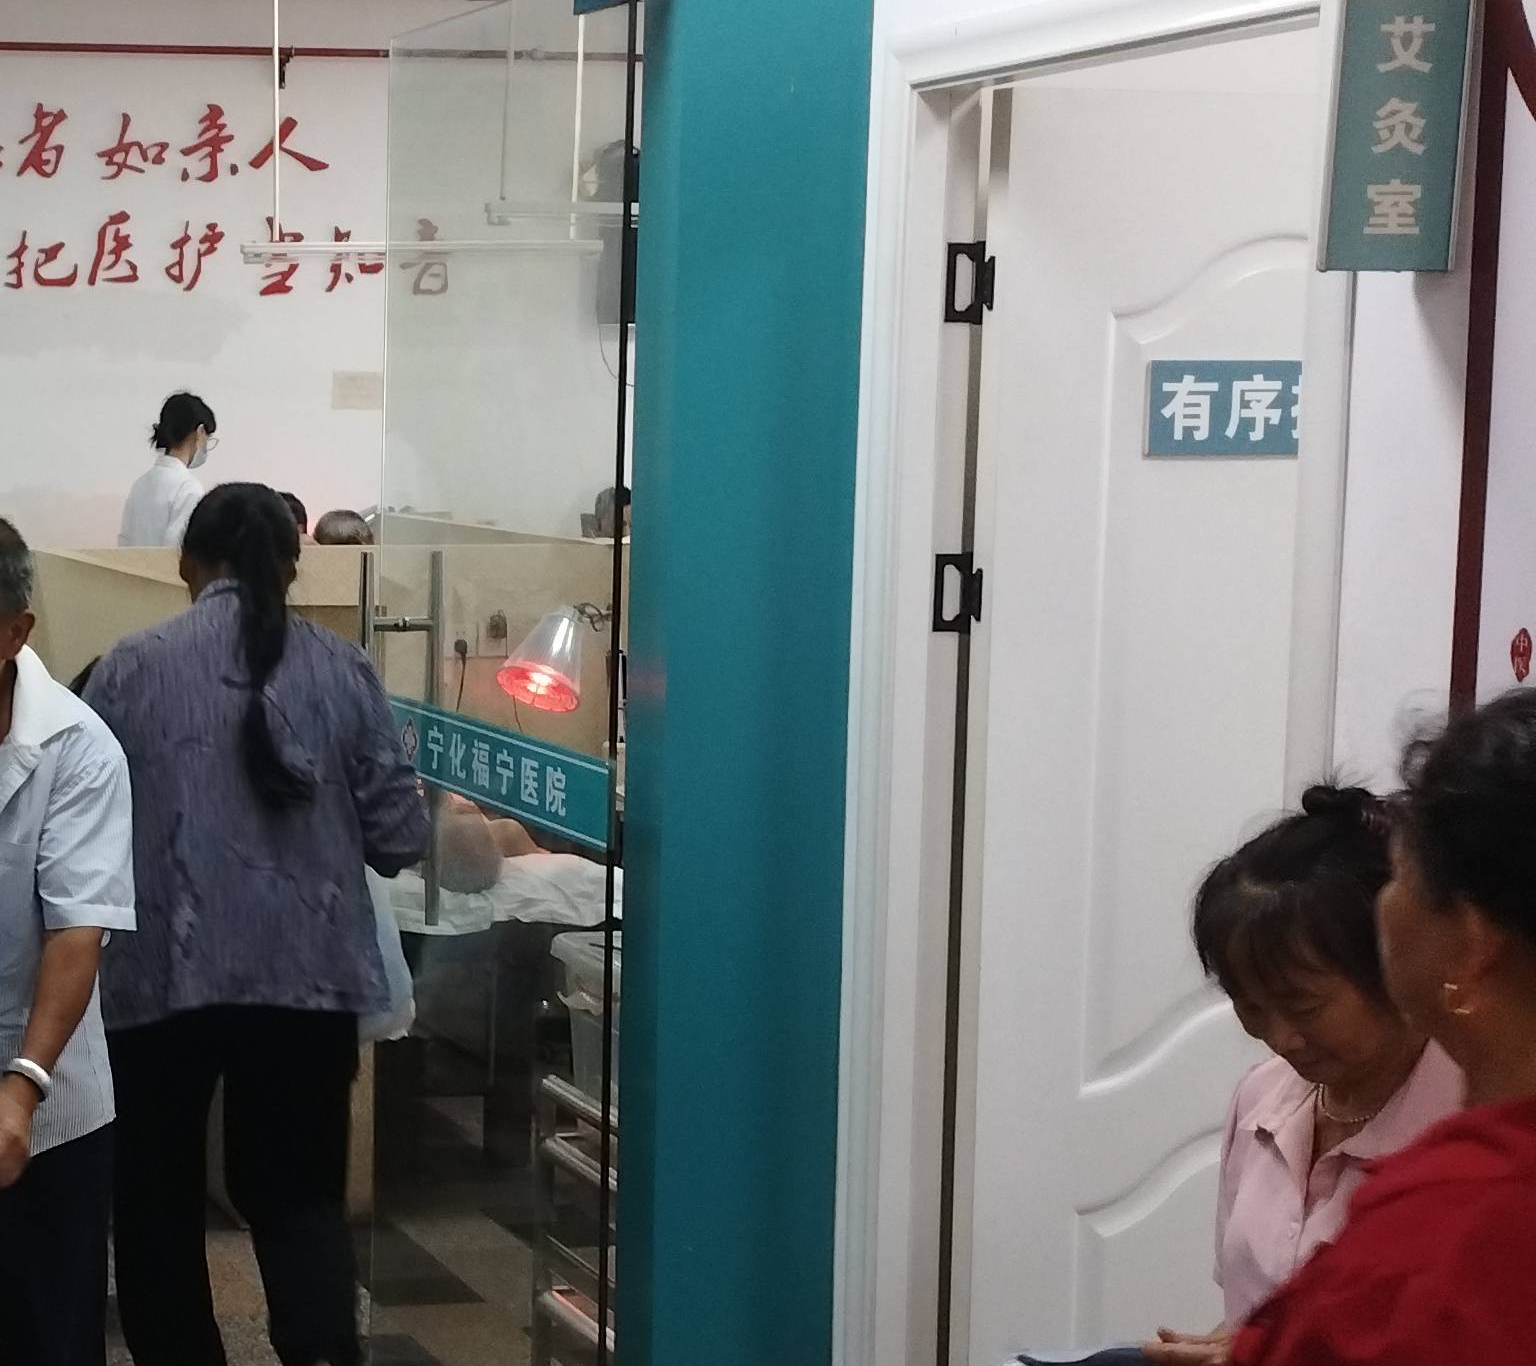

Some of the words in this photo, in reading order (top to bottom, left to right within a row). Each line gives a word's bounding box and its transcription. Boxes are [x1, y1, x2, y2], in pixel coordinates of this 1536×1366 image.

[1362, 15, 1437, 237] 艾灸室
[1160, 373, 1303, 442] 有序
[426, 724, 567, 818] 宁化福宁医院
